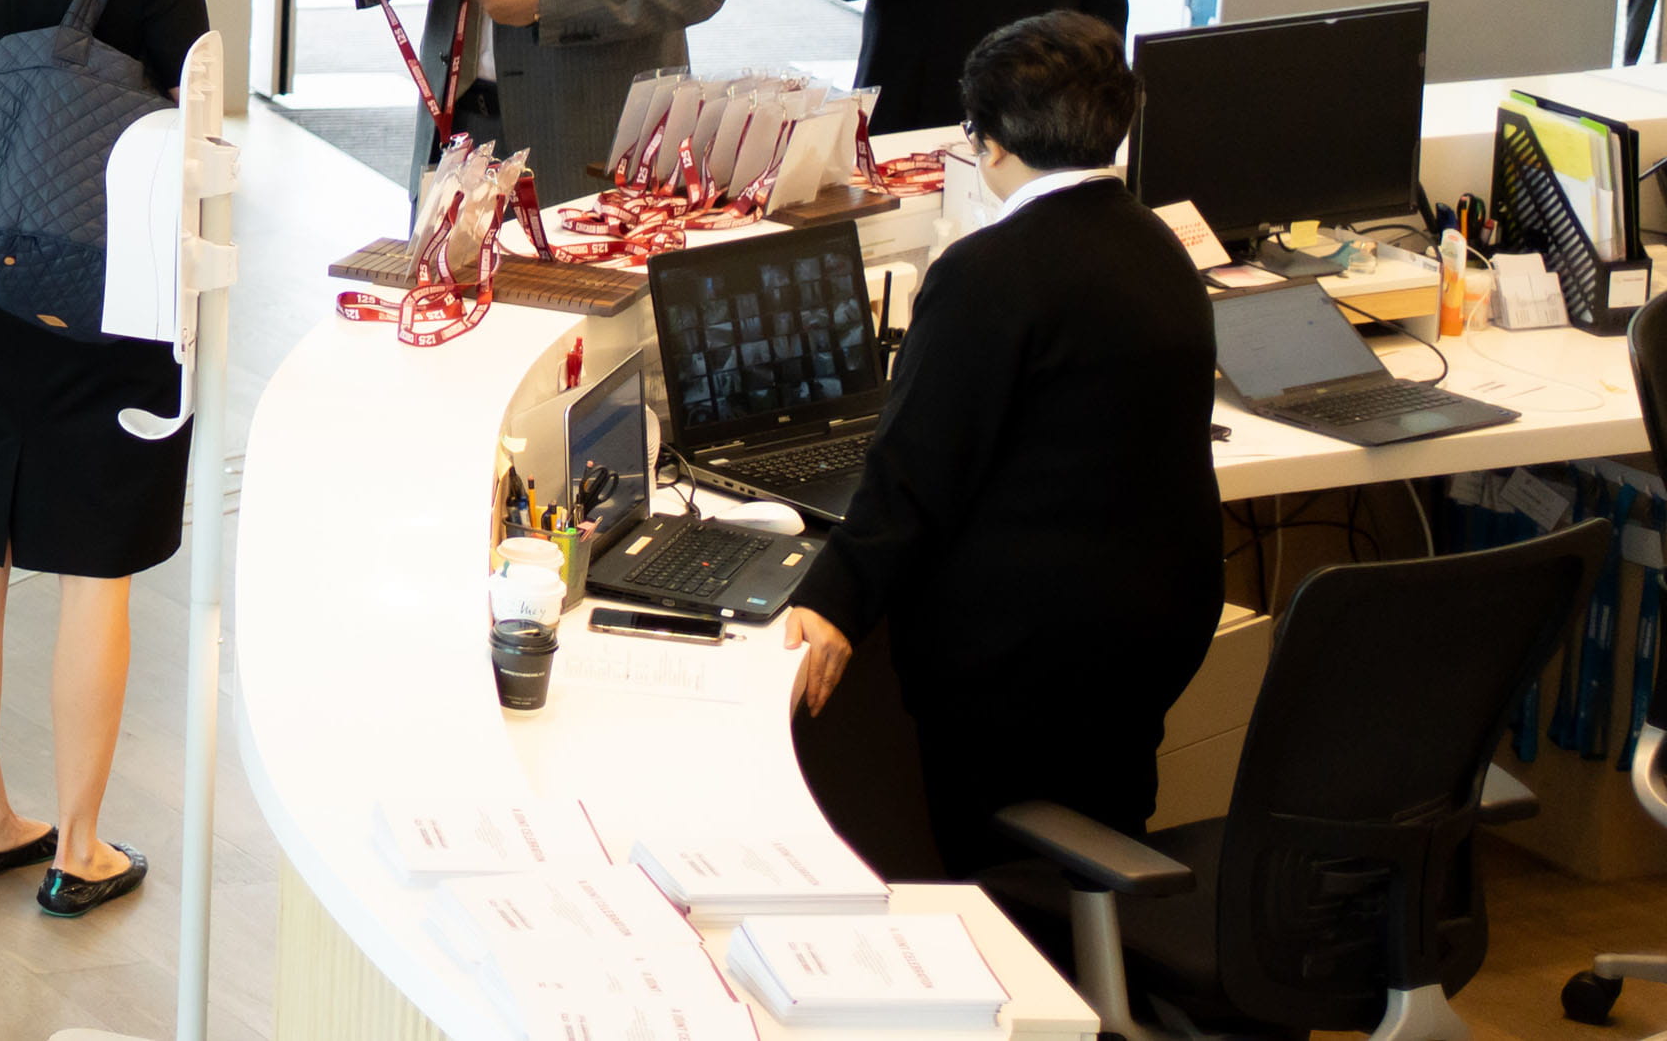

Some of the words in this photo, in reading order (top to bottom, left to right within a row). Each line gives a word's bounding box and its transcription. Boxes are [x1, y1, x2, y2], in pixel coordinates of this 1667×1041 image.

[681, 149, 693, 168] 125
[636, 167, 649, 183] 125
[357, 294, 376, 304] 125
